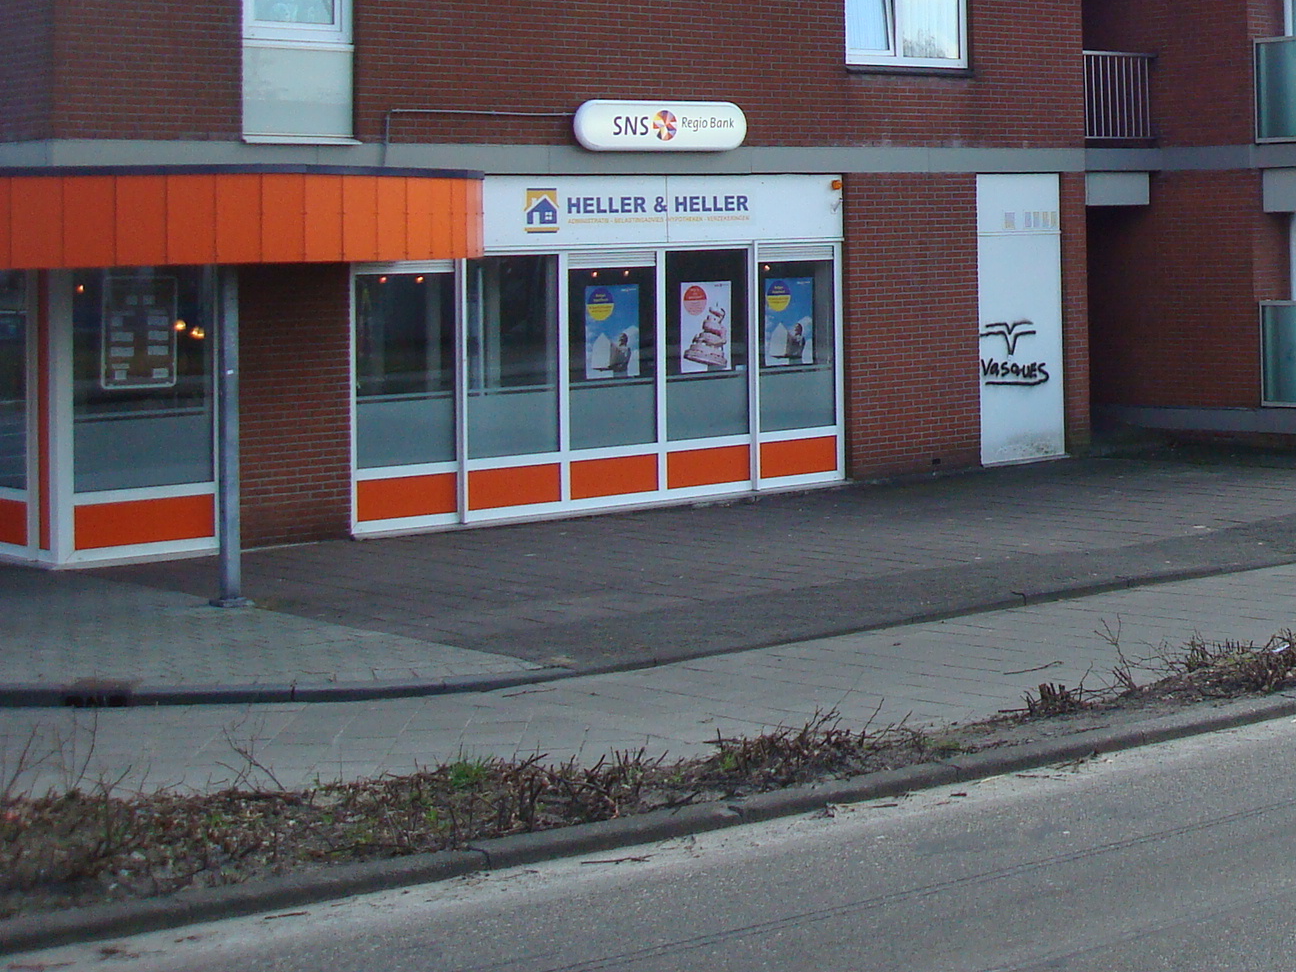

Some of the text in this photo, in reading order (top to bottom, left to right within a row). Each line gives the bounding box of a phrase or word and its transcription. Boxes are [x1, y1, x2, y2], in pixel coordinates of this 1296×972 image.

[613, 116, 735, 136] SNS Regio Bank
[567, 195, 749, 214] HELLER & HELLER
